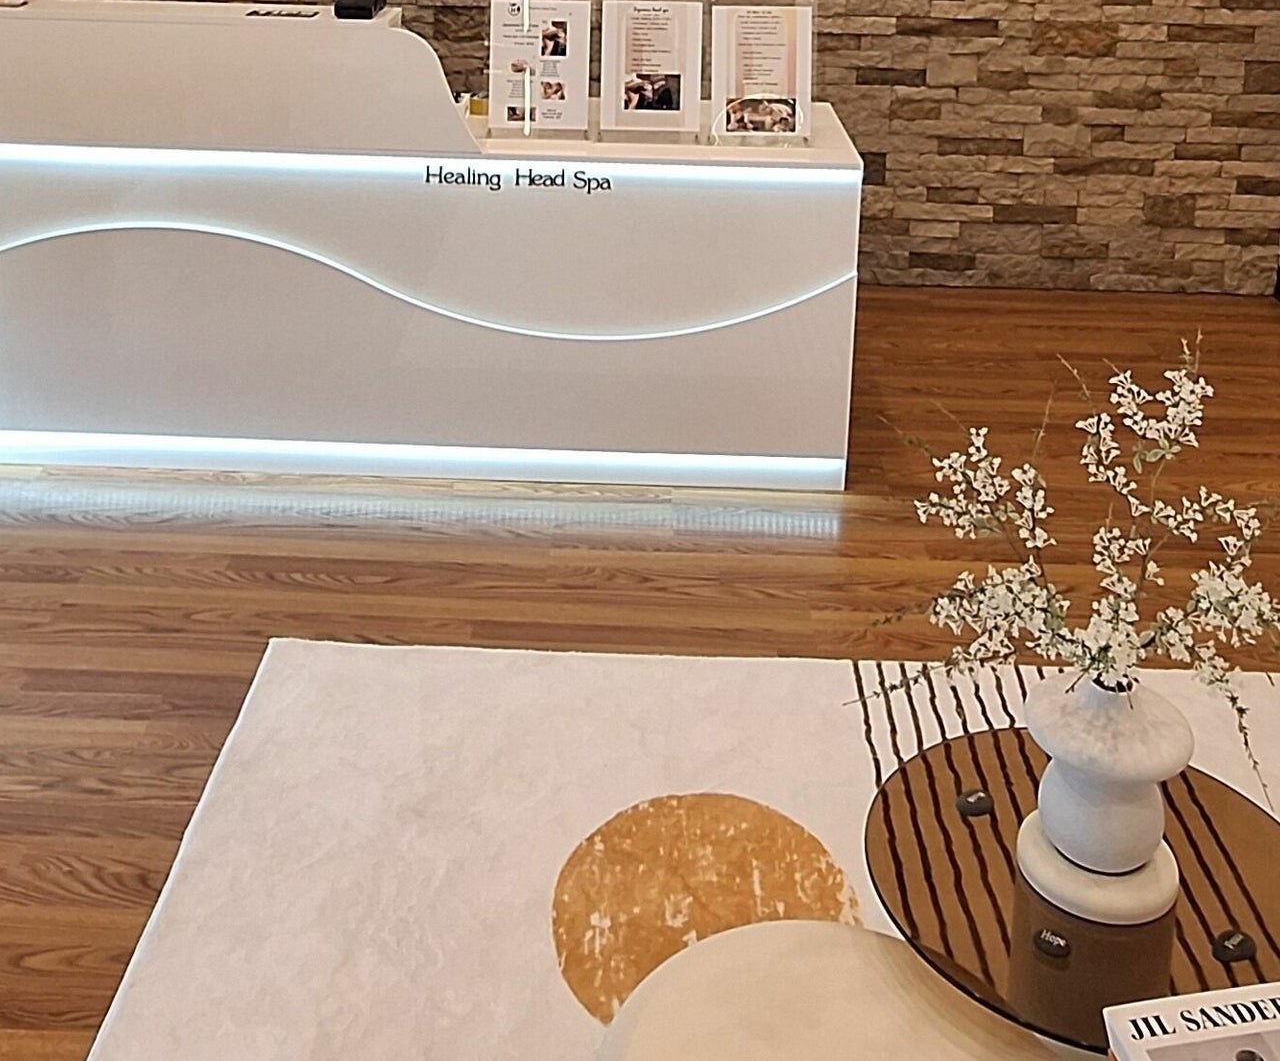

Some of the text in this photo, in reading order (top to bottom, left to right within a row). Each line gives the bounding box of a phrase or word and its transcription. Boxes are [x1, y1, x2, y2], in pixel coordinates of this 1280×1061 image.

[425, 165, 612, 194] Healing Head Spa
[1128, 1015, 1177, 1040] JIL
